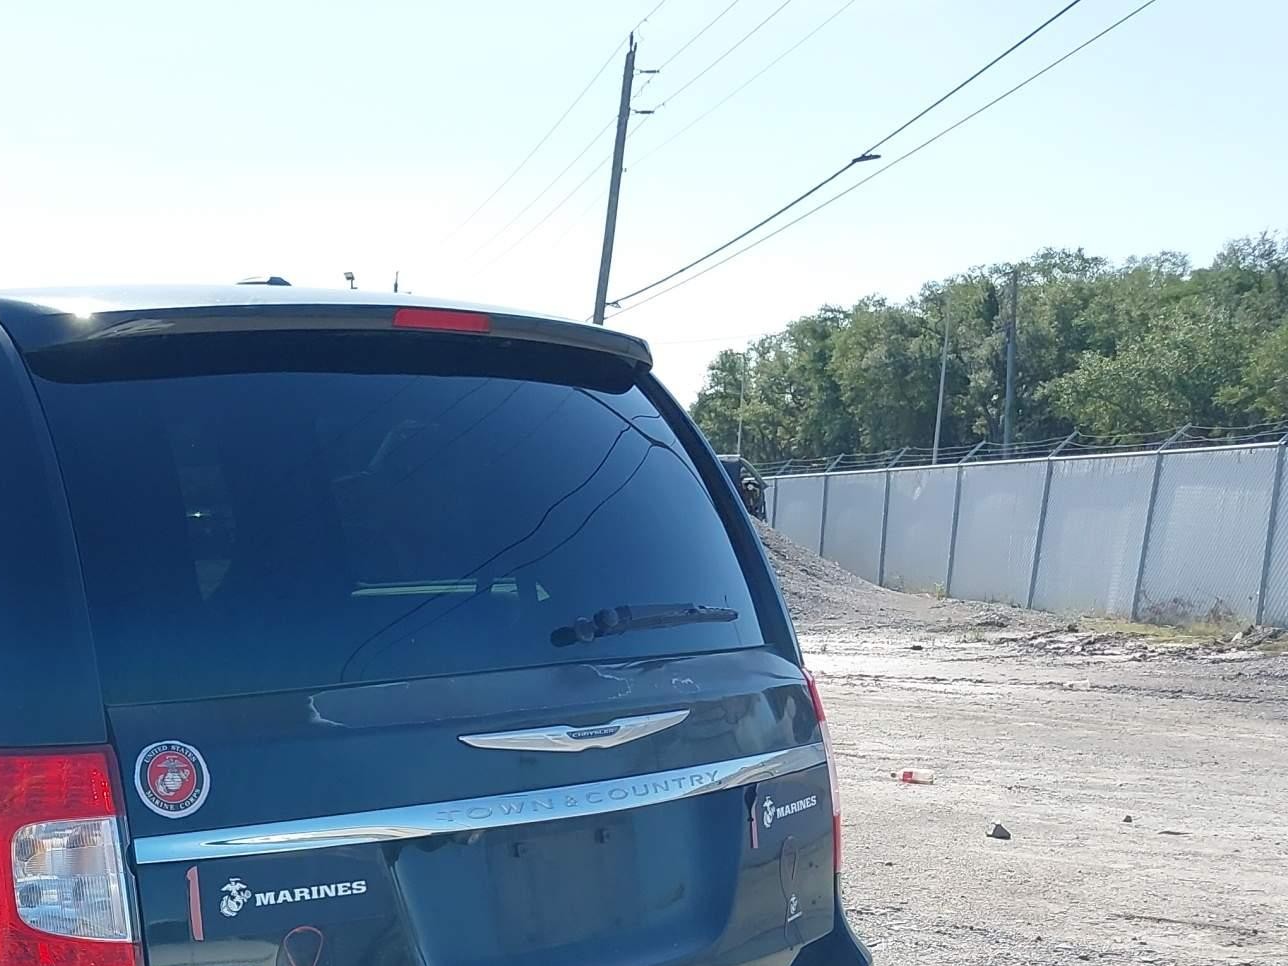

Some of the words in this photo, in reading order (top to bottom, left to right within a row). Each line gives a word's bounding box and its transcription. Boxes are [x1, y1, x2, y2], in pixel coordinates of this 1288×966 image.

[144, 745, 168, 763] UNITED
[171, 745, 197, 762] STATES
[145, 790, 176, 811] MARINE
[179, 788, 201, 809] CORPS
[437, 798, 553, 822] TOWN
[564, 796, 578, 808] &
[588, 770, 721, 804] COUNTRY
[776, 795, 817, 819] MARINES
[255, 880, 367, 906] MARINES
